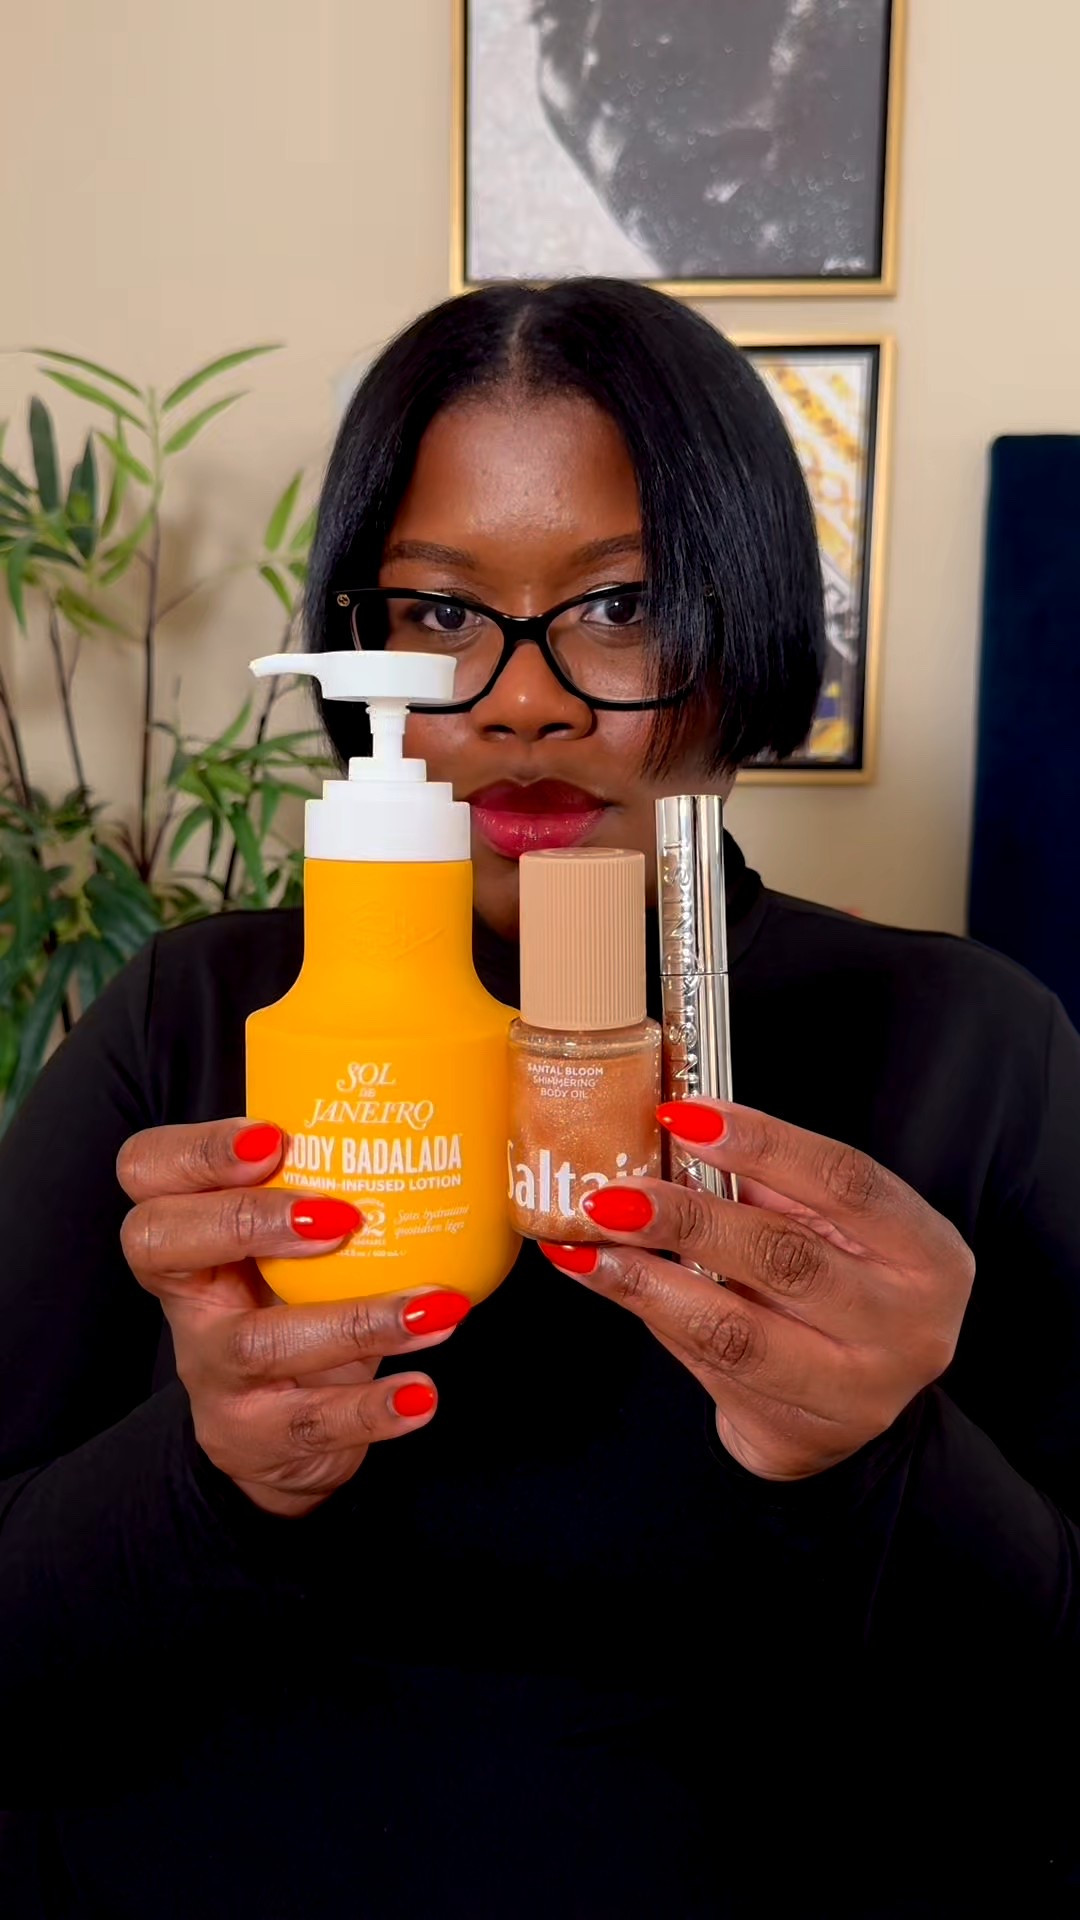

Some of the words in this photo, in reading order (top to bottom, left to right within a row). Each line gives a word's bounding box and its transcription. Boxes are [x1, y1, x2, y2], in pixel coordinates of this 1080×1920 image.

[336, 1061, 397, 1093] SOL
[528, 1063, 562, 1076] SANTAL
[565, 1064, 604, 1076] BLOOM
[533, 1076, 596, 1088] SHIMMERING
[540, 1087, 568, 1098] BODY
[571, 1088, 588, 1098] OIL
[304, 1098, 435, 1132] JANEIRO
[342, 1133, 463, 1175] BADALADA
[409, 1173, 463, 1191] LOTION
